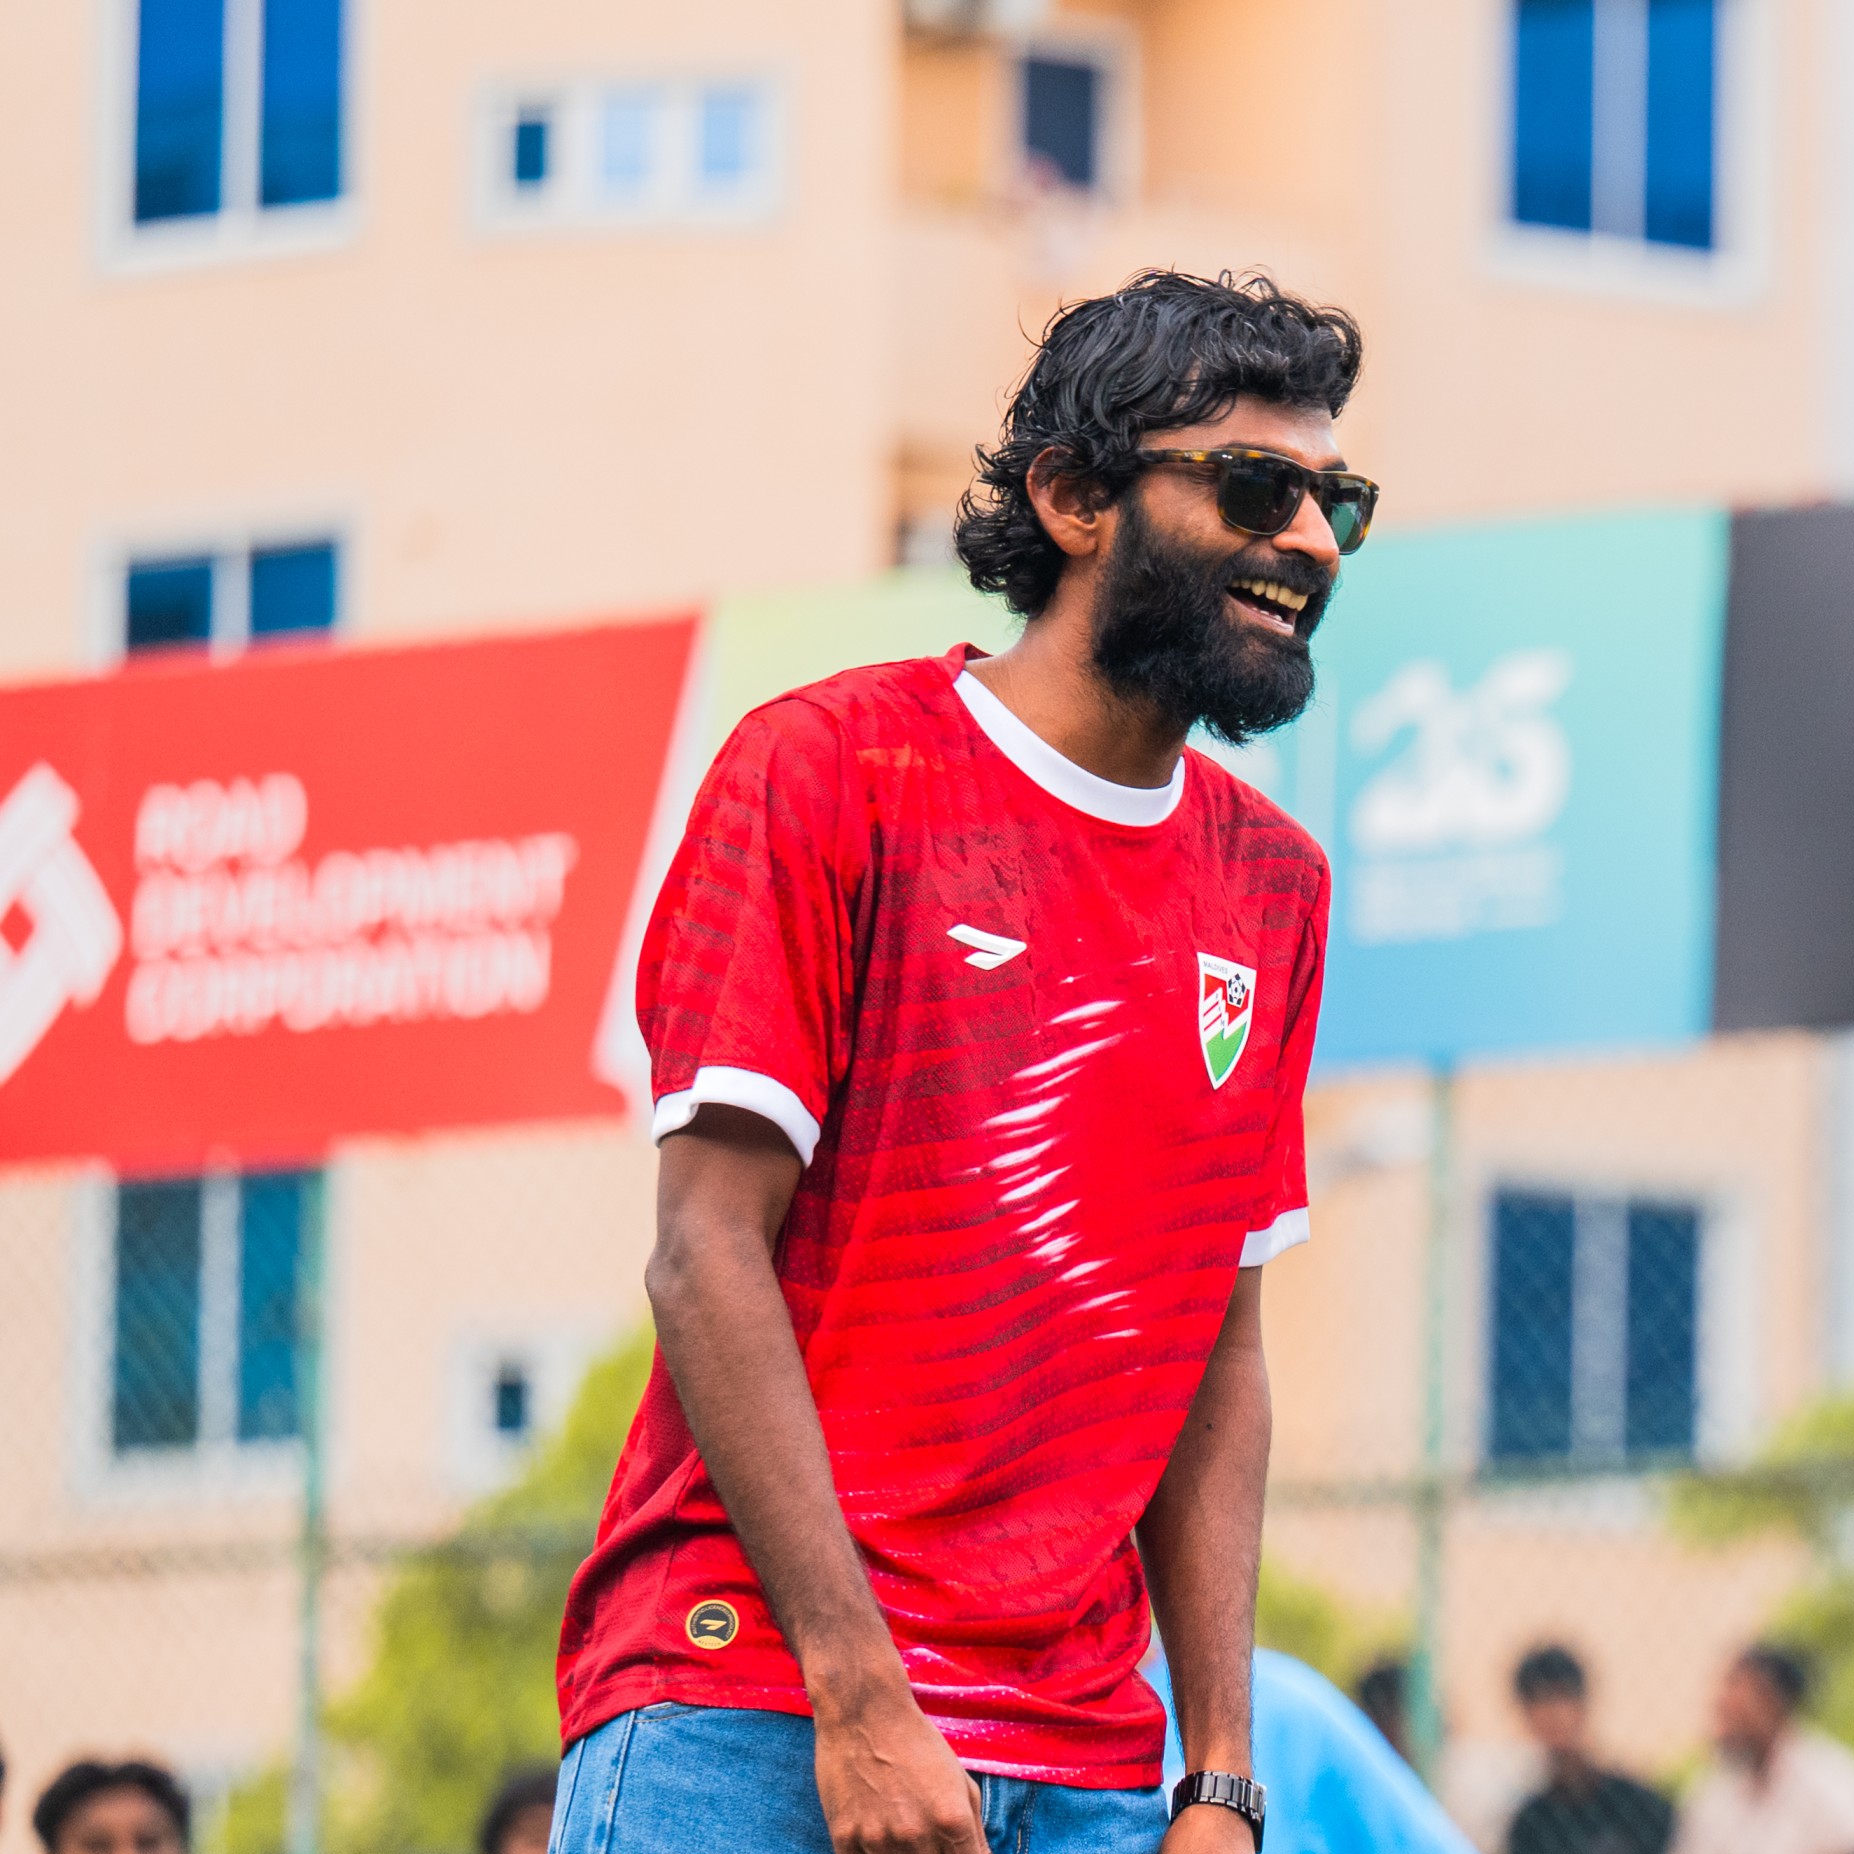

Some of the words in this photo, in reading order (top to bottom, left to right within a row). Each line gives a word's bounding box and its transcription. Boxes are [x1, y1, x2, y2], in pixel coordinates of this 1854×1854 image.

[137, 776, 306, 864] ROAD
[133, 836, 575, 956] DEVELOPMENT
[129, 934, 550, 1041] CORPORATION
[1203, 961, 1228, 974] MALDIVES
